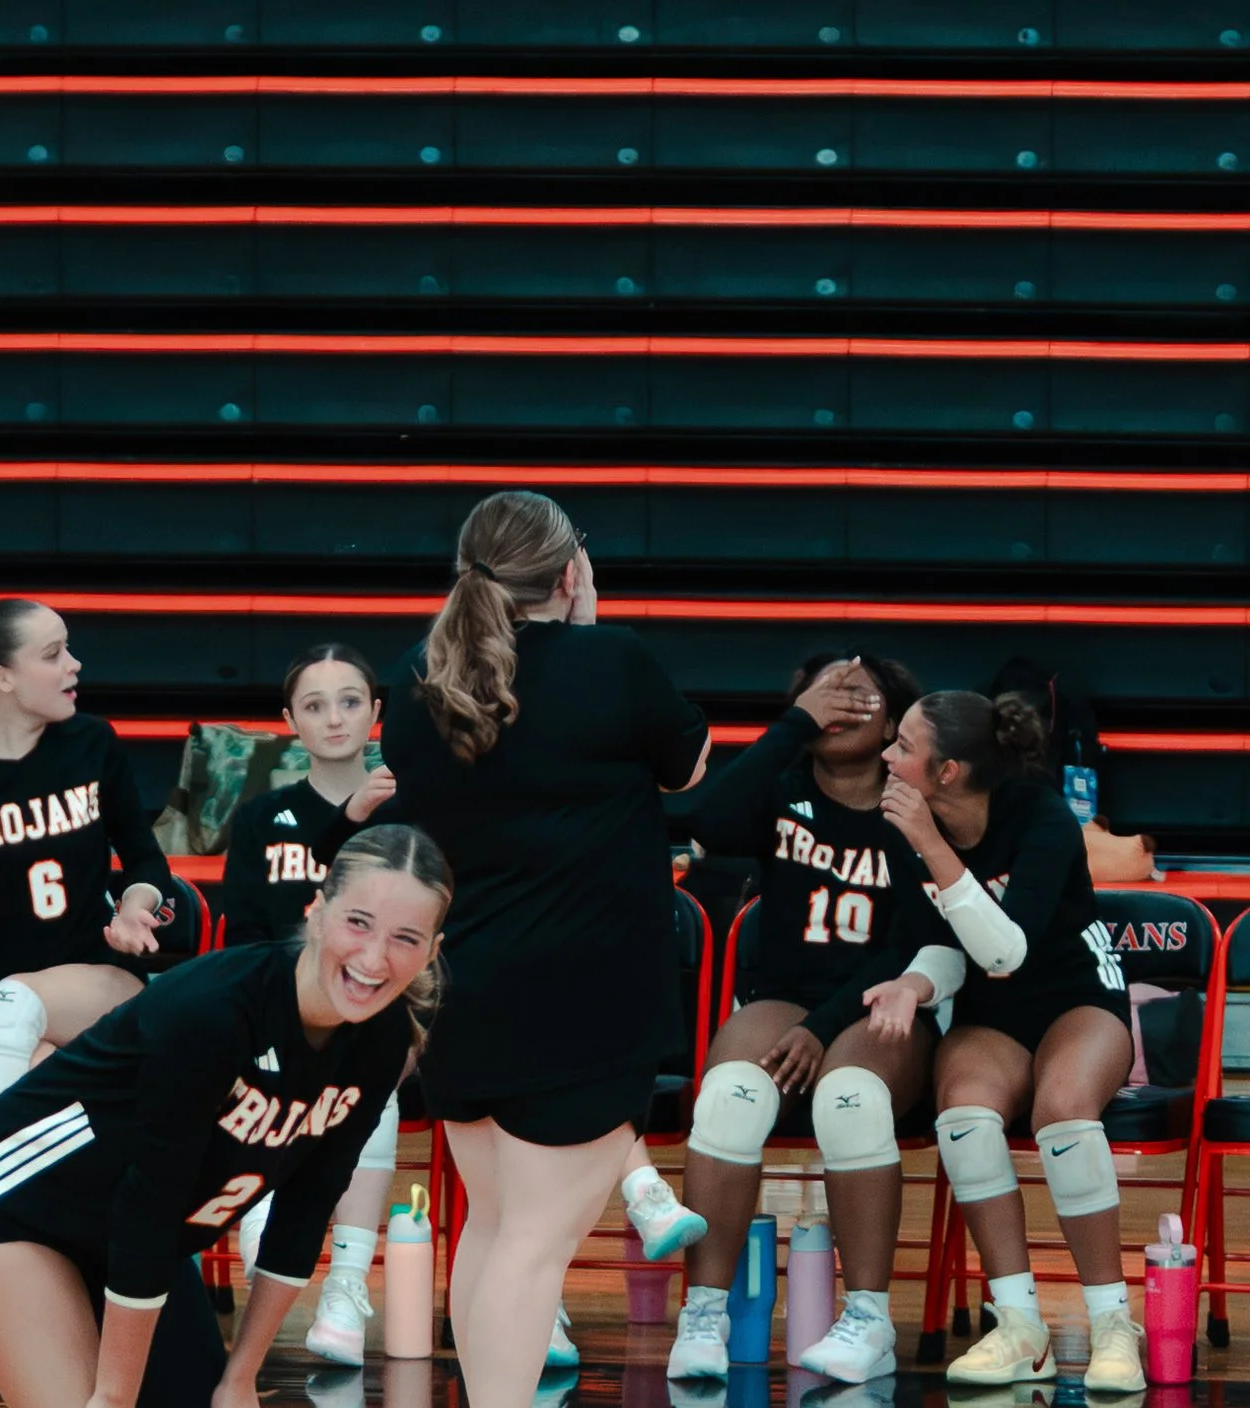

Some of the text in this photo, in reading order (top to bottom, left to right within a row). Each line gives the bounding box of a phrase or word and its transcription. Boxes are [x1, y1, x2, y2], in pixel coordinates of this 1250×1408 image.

[28, 858, 68, 920] 6
[265, 841, 331, 883] TRO
[803, 885, 874, 945] 10
[185, 1172, 265, 1227] 2
